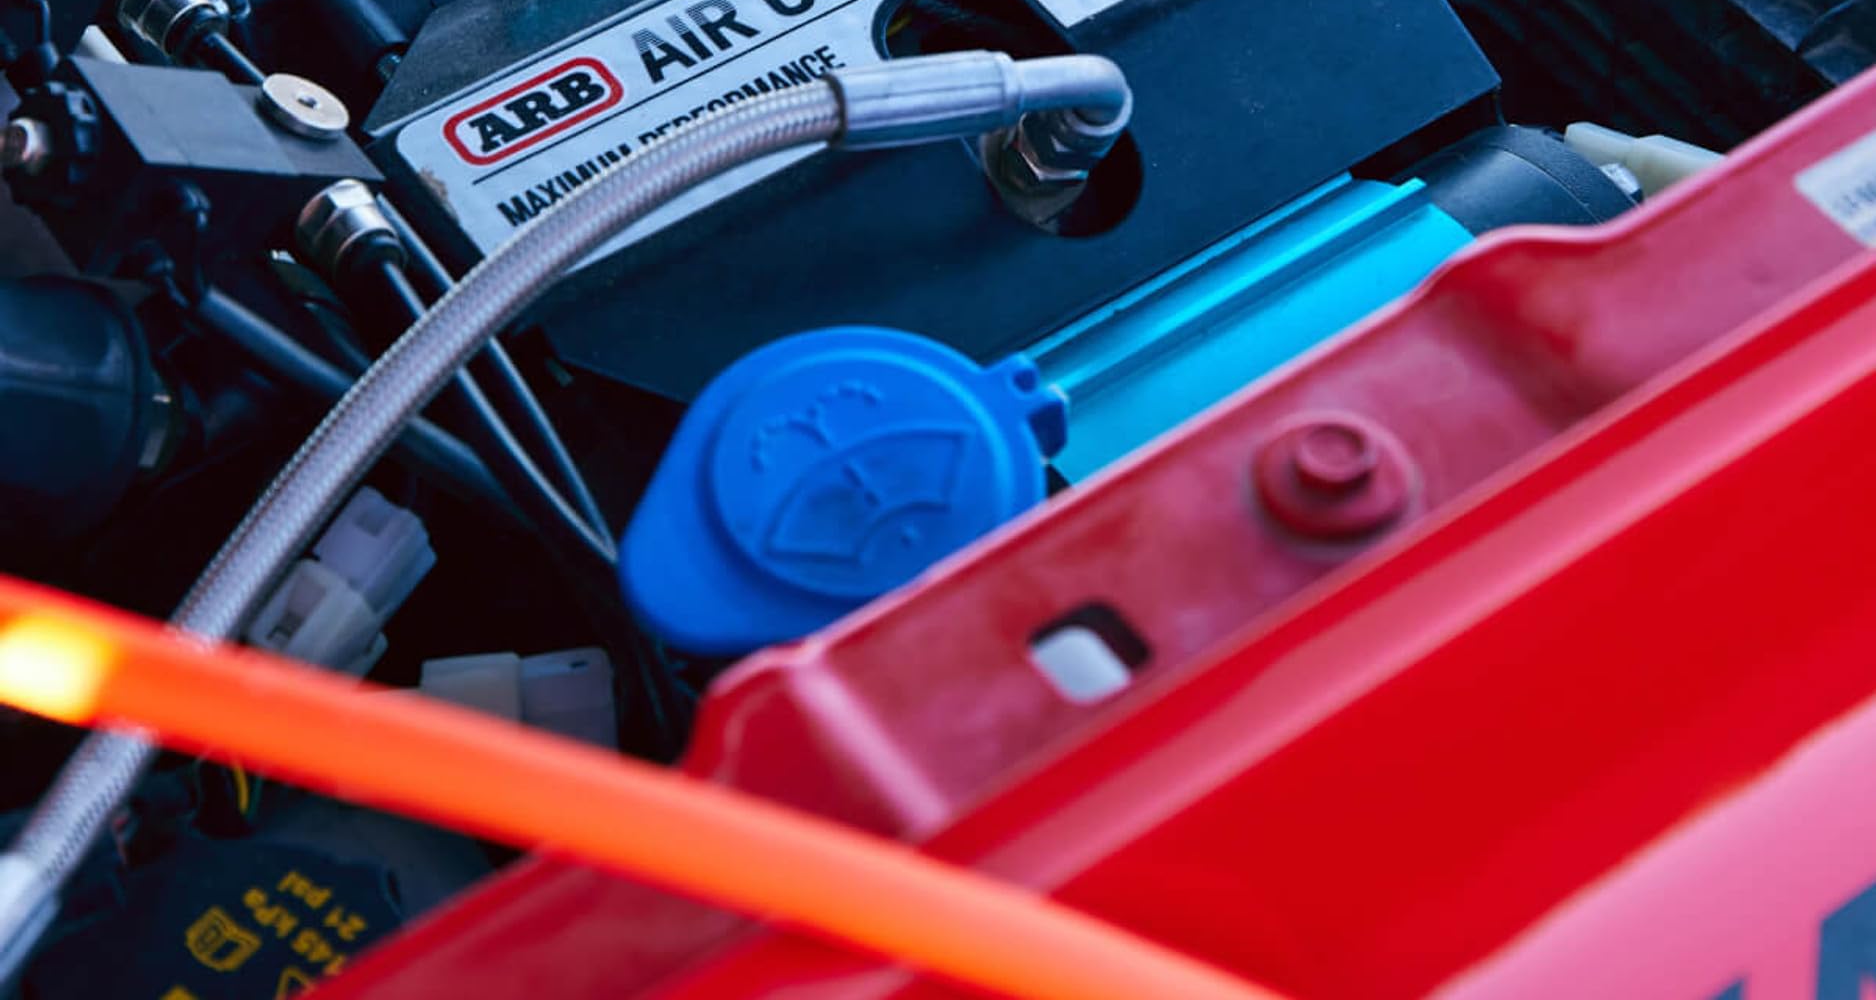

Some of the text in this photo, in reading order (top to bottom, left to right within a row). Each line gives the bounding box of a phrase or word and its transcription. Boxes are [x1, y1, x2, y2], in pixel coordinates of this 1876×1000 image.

[468, 72, 605, 153] ARB
[276, 870, 367, 941] 21 psi
